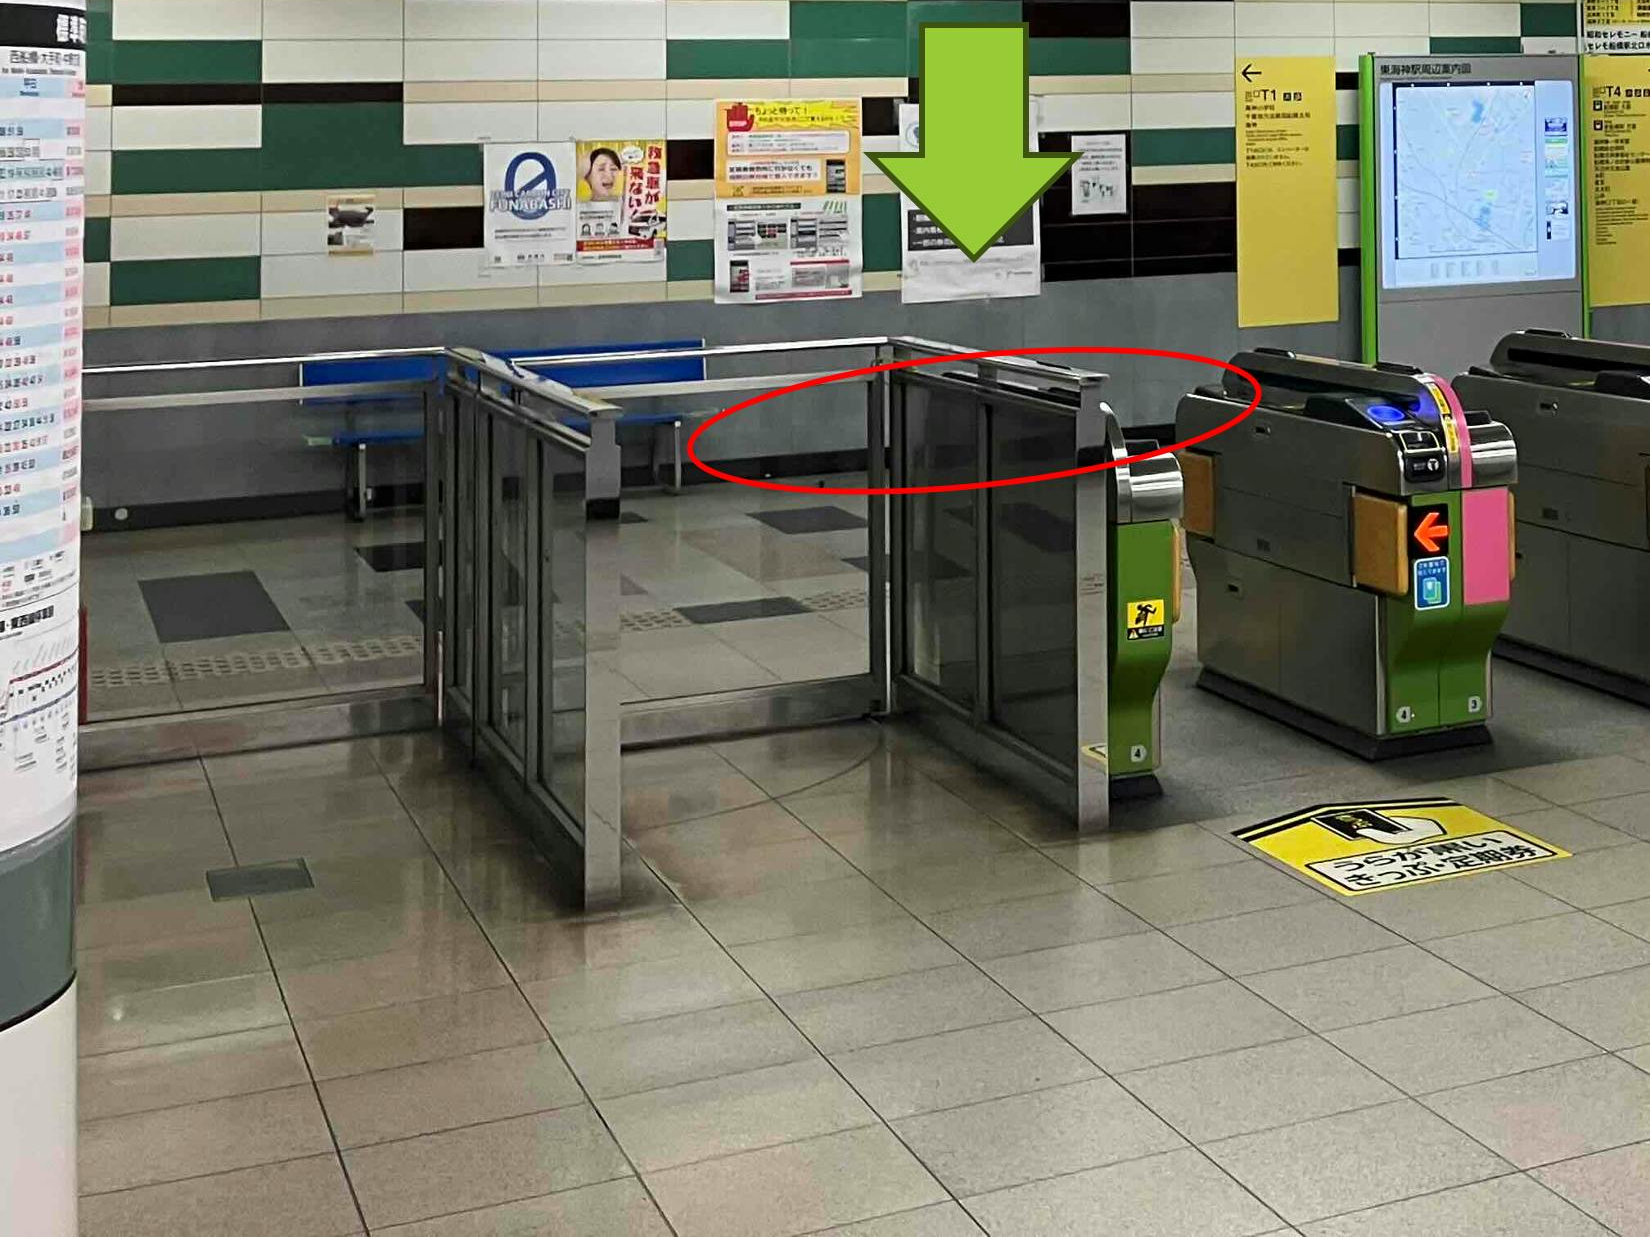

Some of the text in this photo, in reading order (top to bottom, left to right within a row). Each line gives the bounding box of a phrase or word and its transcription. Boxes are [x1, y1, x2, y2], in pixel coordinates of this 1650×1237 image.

[490, 197, 572, 213] FUNABASHI
[1332, 835, 1503, 872] うらが黒い
[1344, 845, 1538, 887] きっぷ・定期券
